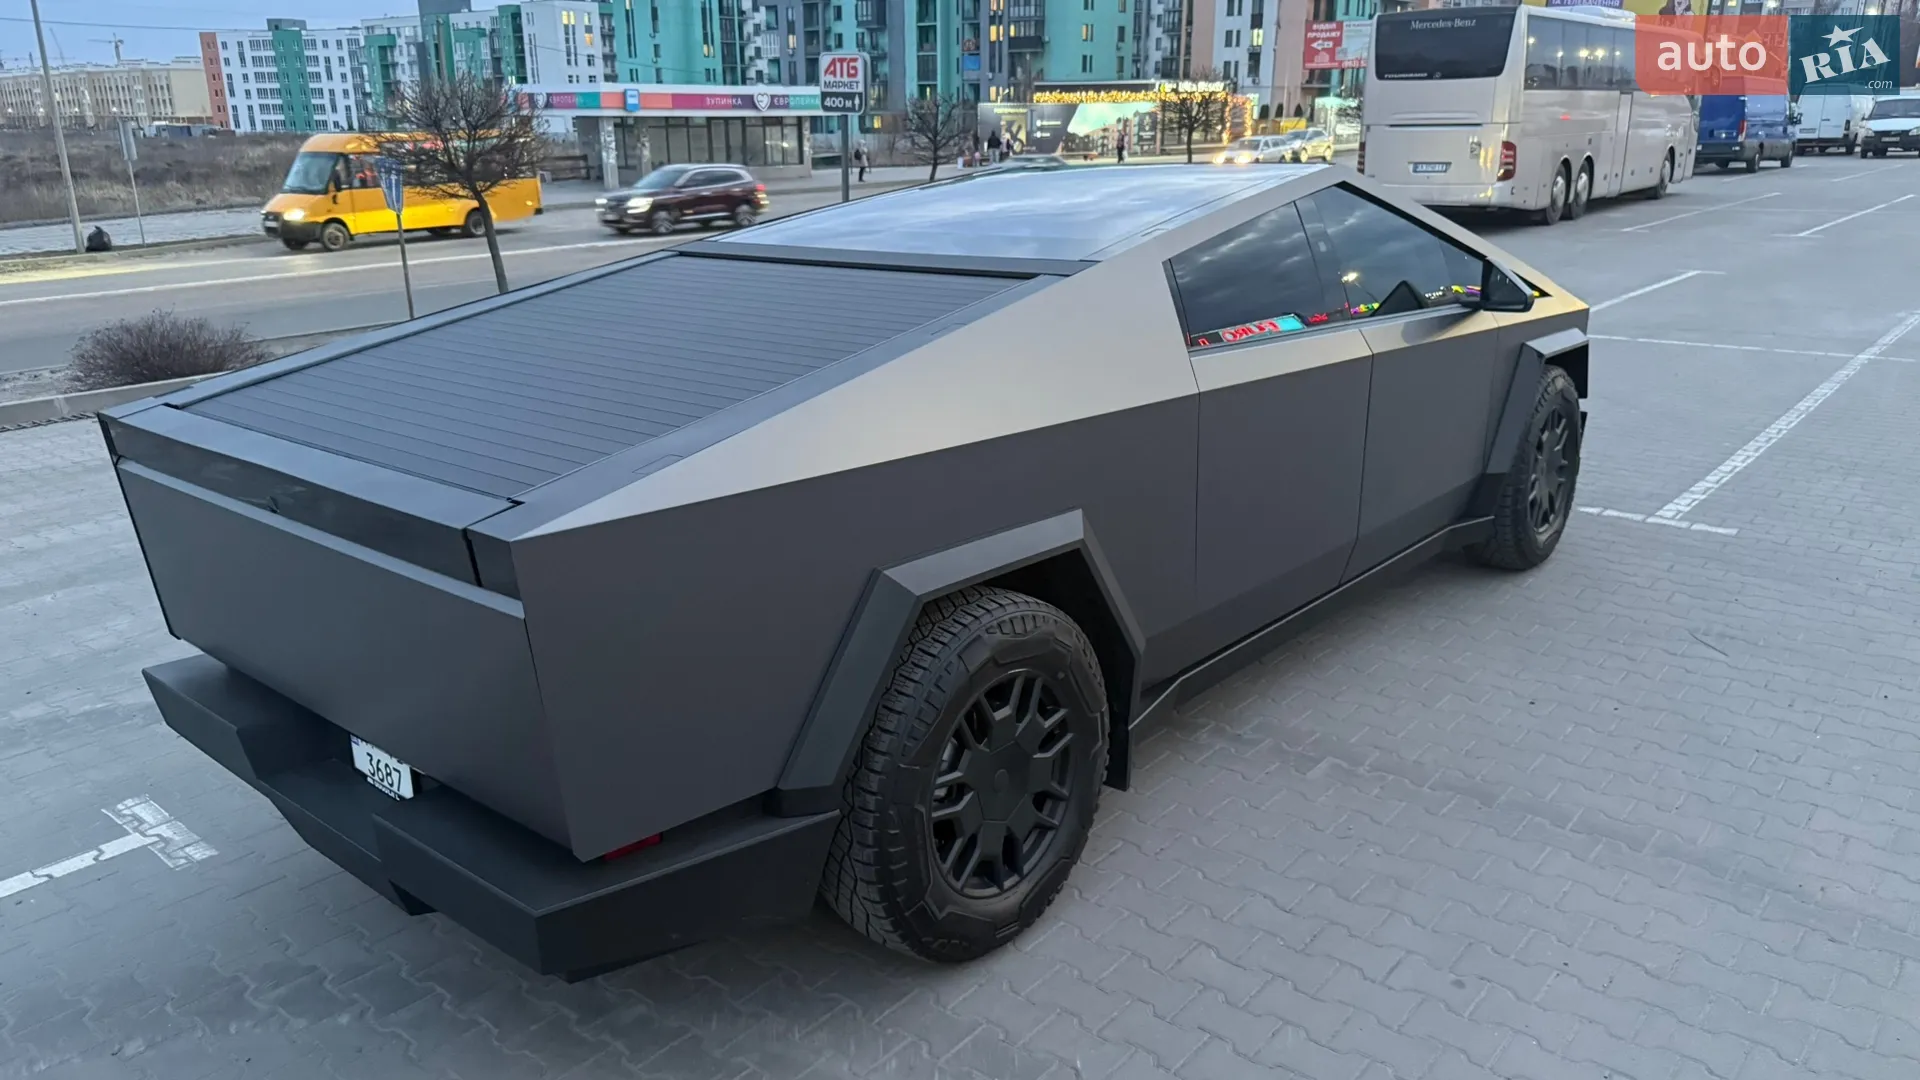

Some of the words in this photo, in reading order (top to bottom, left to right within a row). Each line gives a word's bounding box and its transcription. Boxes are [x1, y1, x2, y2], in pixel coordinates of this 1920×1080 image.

[1410, 18, 1476, 30] Mercedes-Benz
[824, 57, 859, 78] АТБ
[824, 80, 860, 90] МАРКЕТ
[706, 96, 742, 106] ЗУПИНКА
[824, 97, 844, 107] 400
[366, 752, 402, 793] 3687
